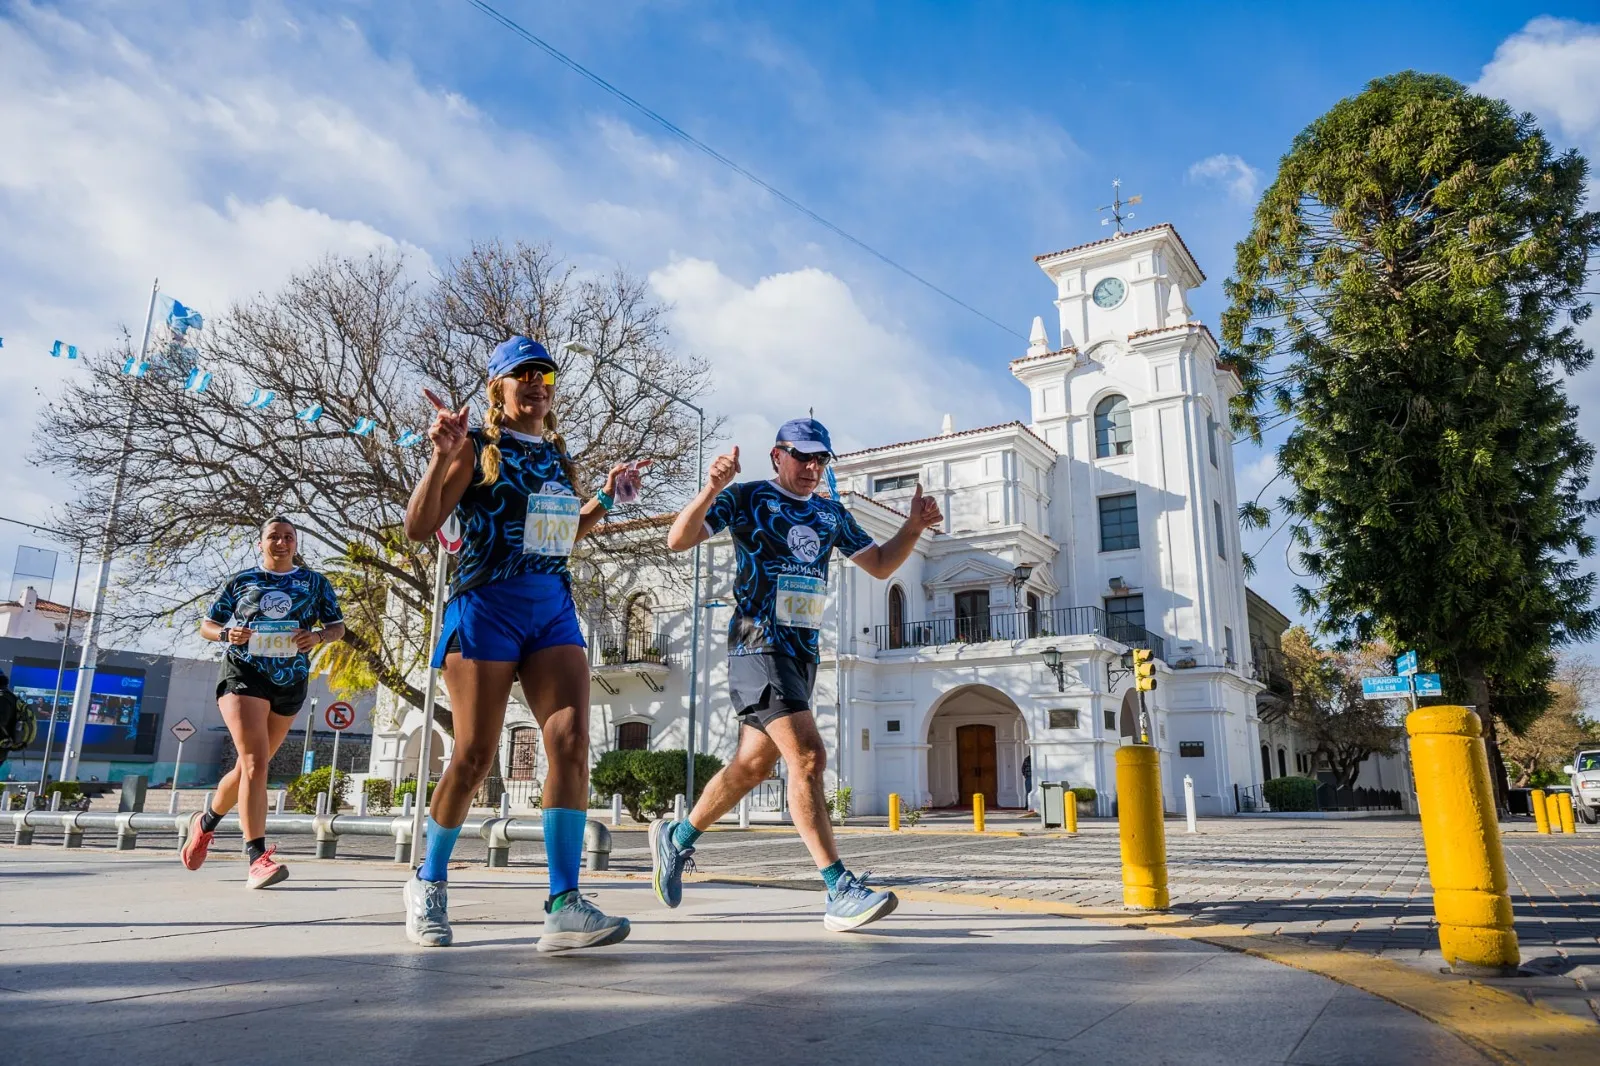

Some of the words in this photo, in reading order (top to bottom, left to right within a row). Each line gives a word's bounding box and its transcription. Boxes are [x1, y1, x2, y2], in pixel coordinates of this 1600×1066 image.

[256, 635, 291, 649] 1161
[1367, 677, 1402, 685] LEANDRO
[1375, 684, 1397, 692] ALEM
